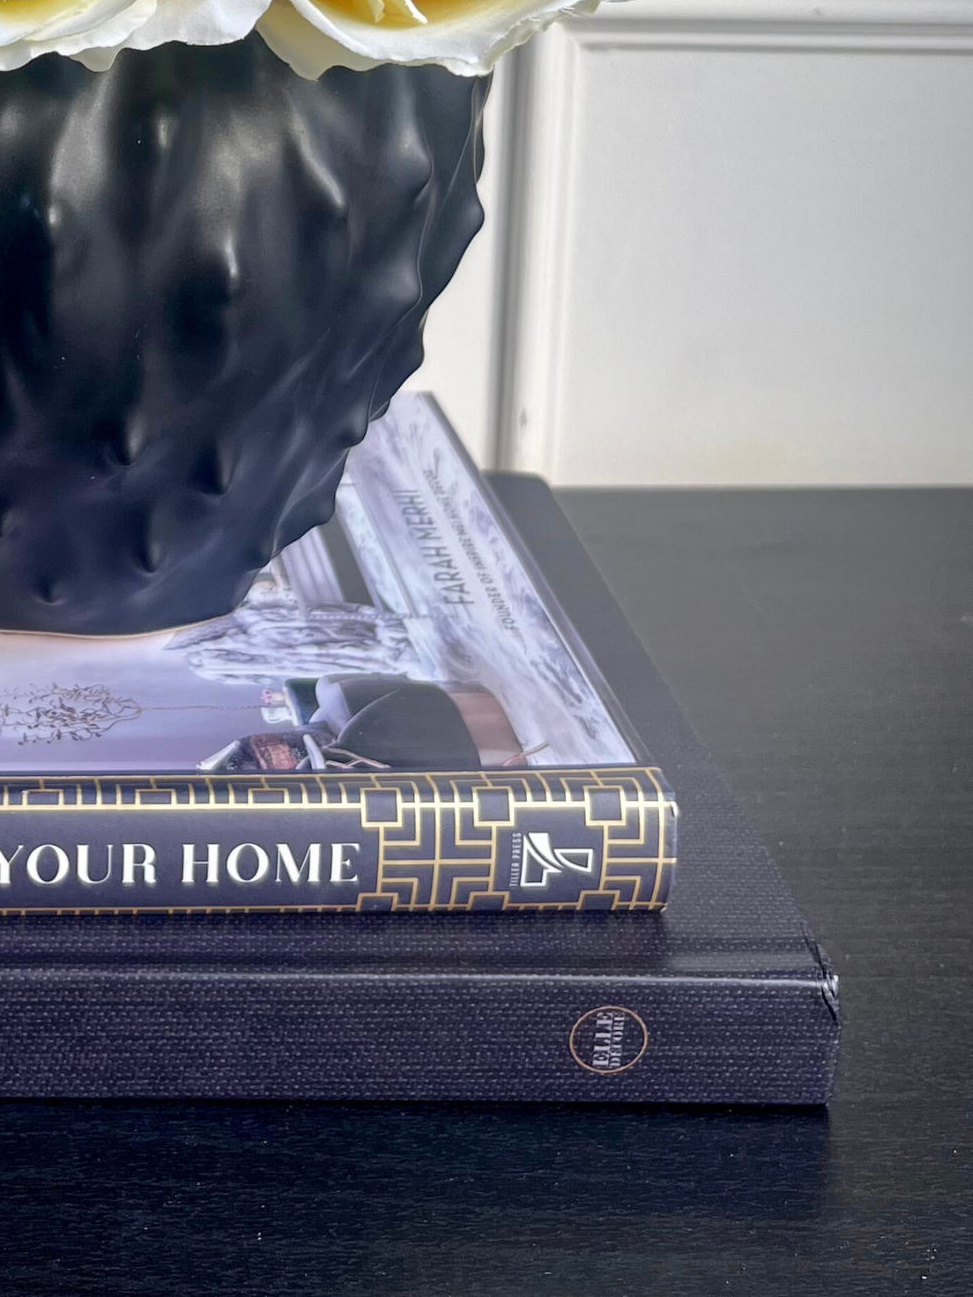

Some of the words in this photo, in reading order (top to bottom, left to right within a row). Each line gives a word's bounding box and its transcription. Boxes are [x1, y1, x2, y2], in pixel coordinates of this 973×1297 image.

[391, 489, 443, 540] MERHI
[422, 546, 475, 604] FARAH
[476, 572, 494, 584] OF
[484, 586, 519, 631] FOUNDER
[180, 841, 361, 883] HOME
[512, 831, 523, 859] PRESS
[592, 1012, 613, 1067] ELLE
